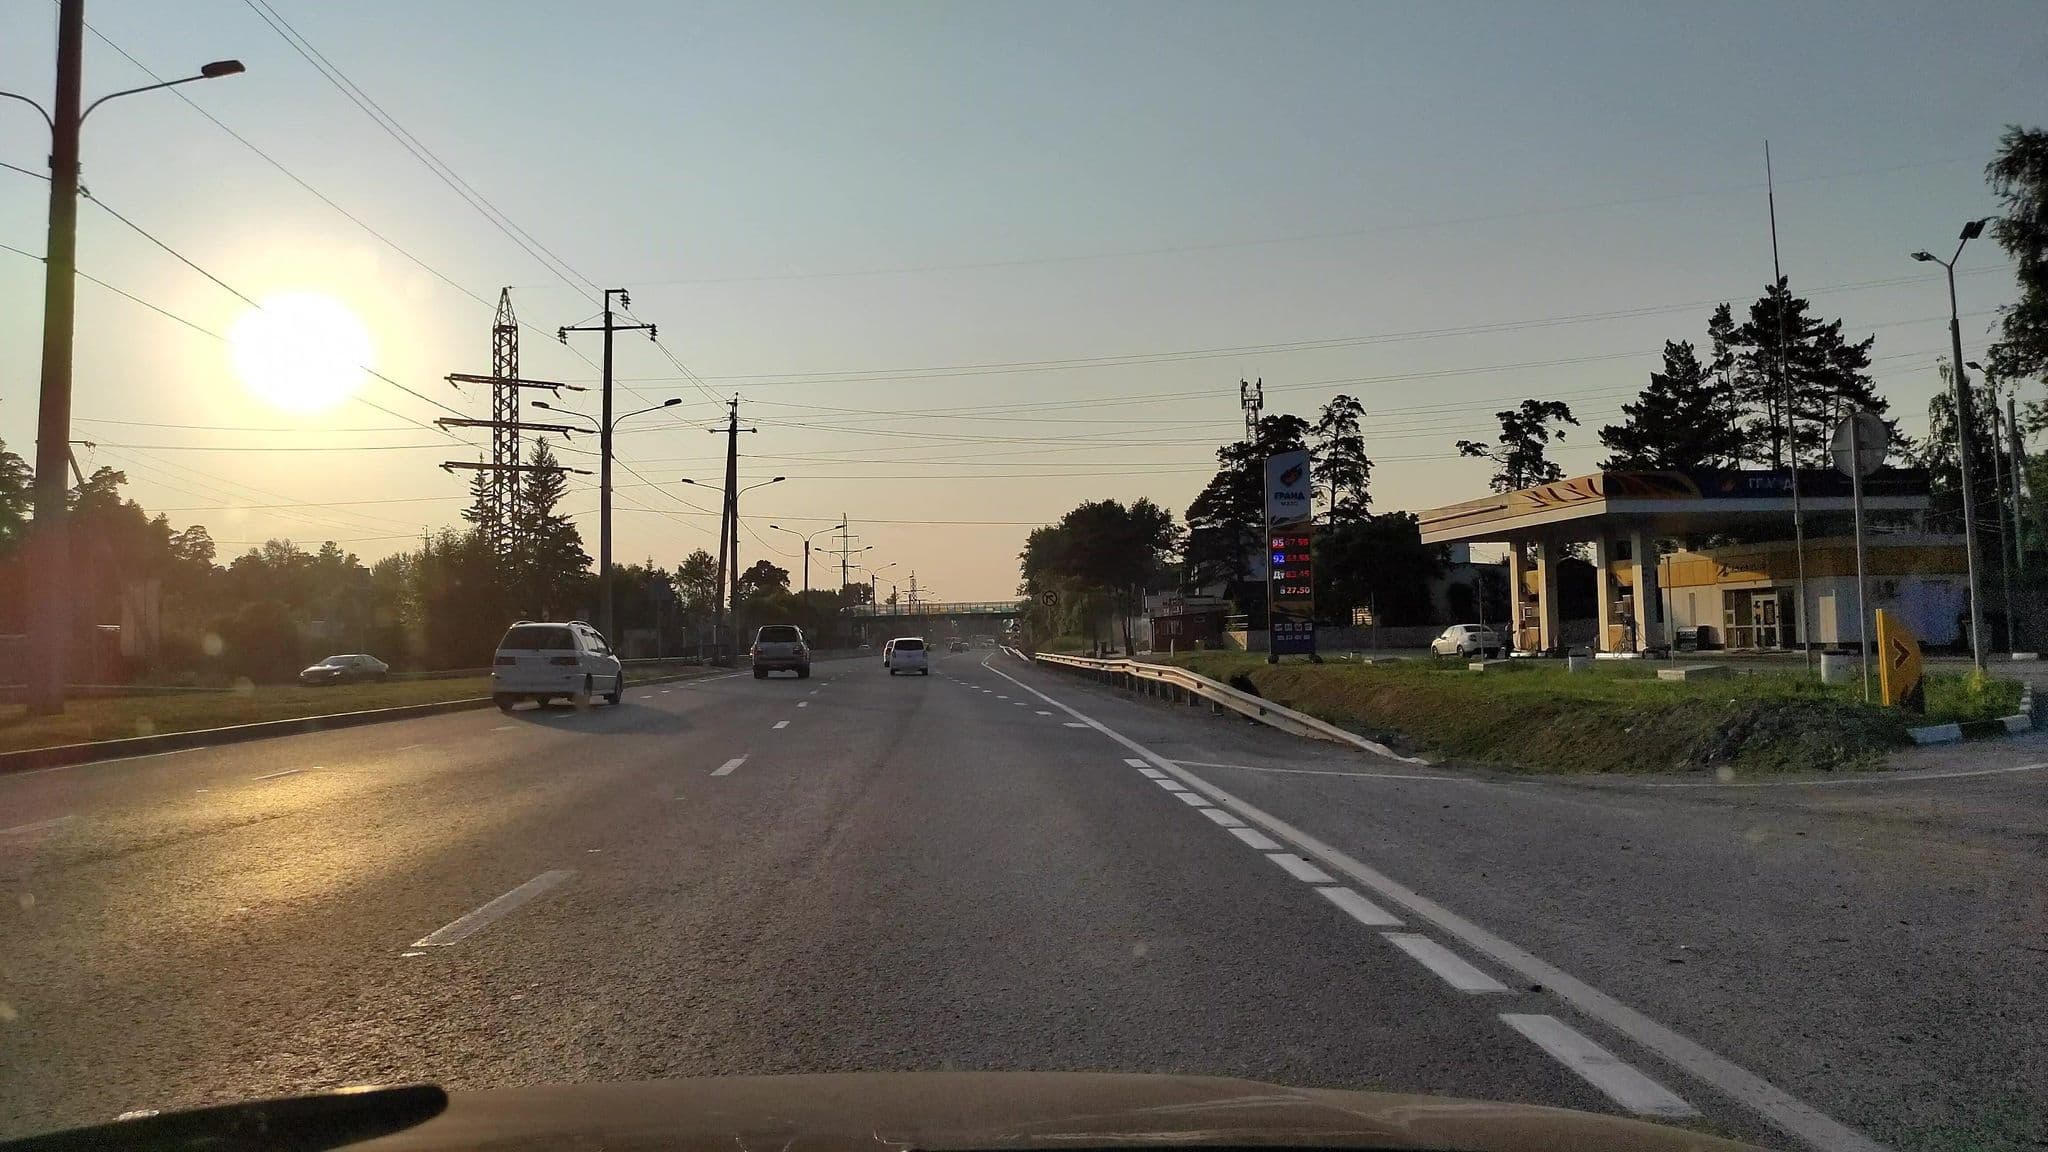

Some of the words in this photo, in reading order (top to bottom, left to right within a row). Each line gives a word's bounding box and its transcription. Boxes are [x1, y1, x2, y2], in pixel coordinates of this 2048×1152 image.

[1272, 538, 1285, 547] 95
[1273, 554, 1285, 563] 92
[1287, 586, 1311, 595] 27.50
